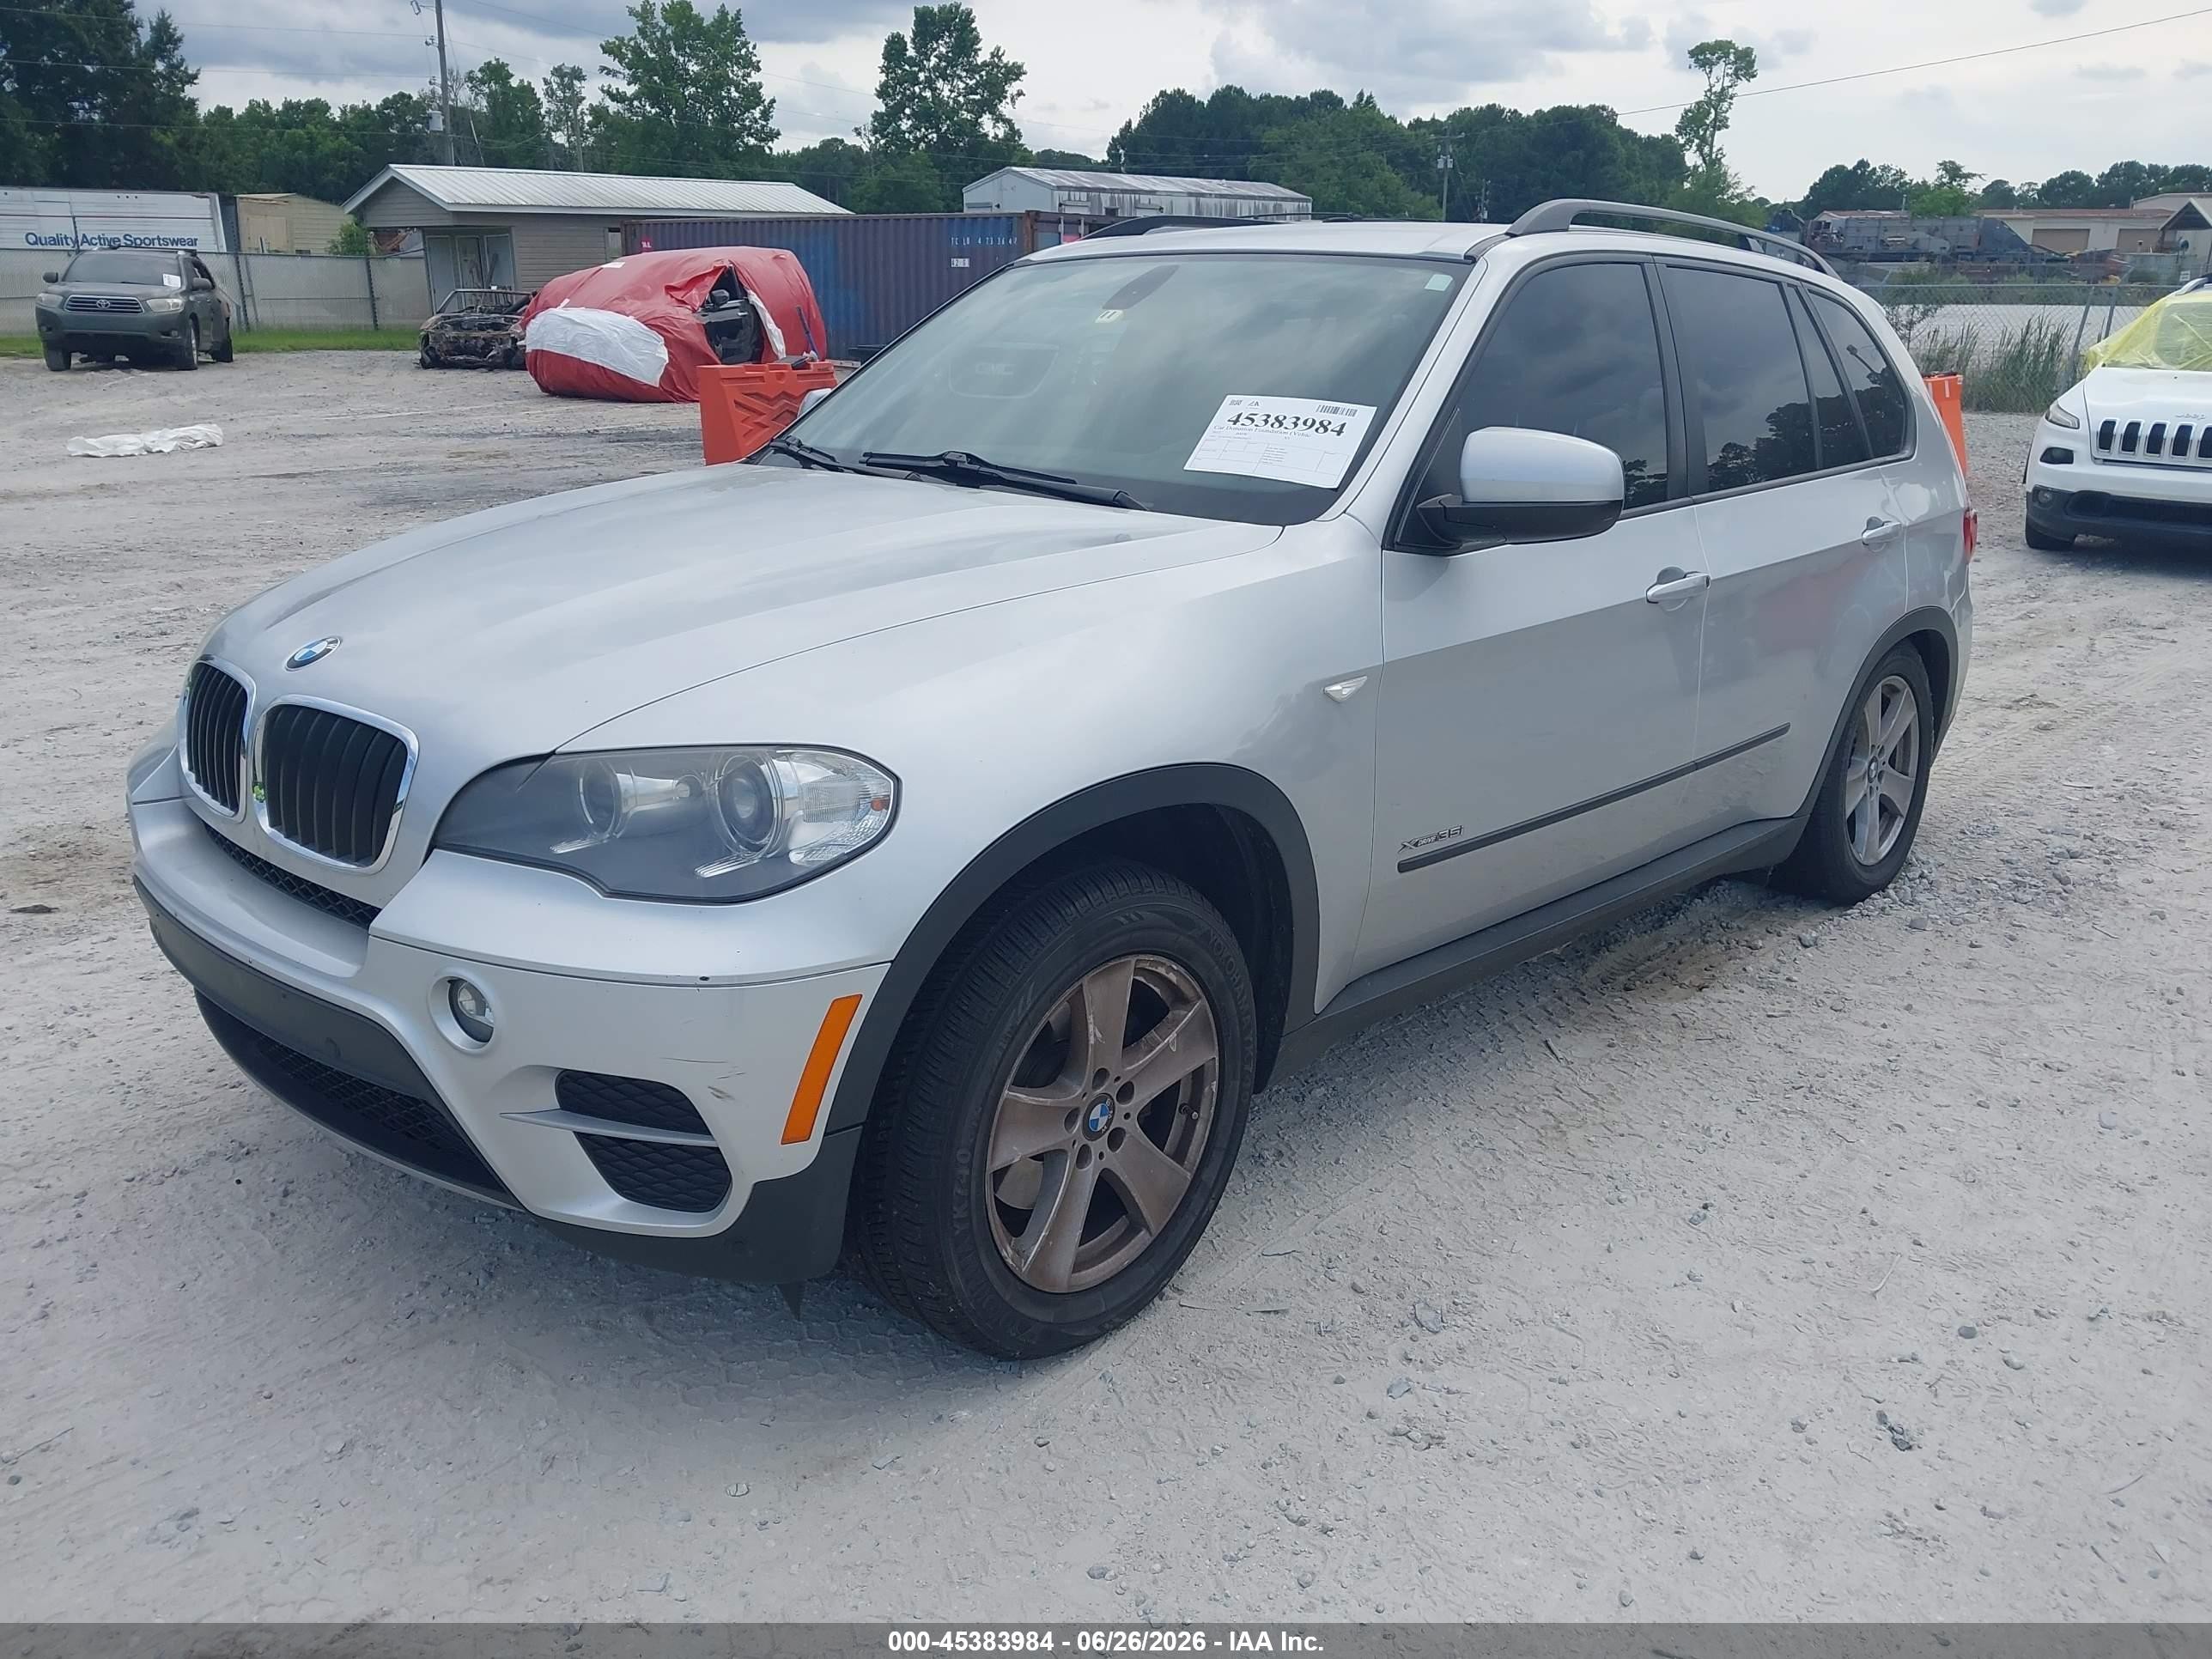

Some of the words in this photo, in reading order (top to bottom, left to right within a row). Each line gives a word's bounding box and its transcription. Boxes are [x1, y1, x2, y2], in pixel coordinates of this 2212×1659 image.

[25, 232, 77, 248] Quality
[80, 234, 121, 247] Active
[123, 234, 198, 247] Sportswear
[1227, 412, 1347, 436] 45383984
